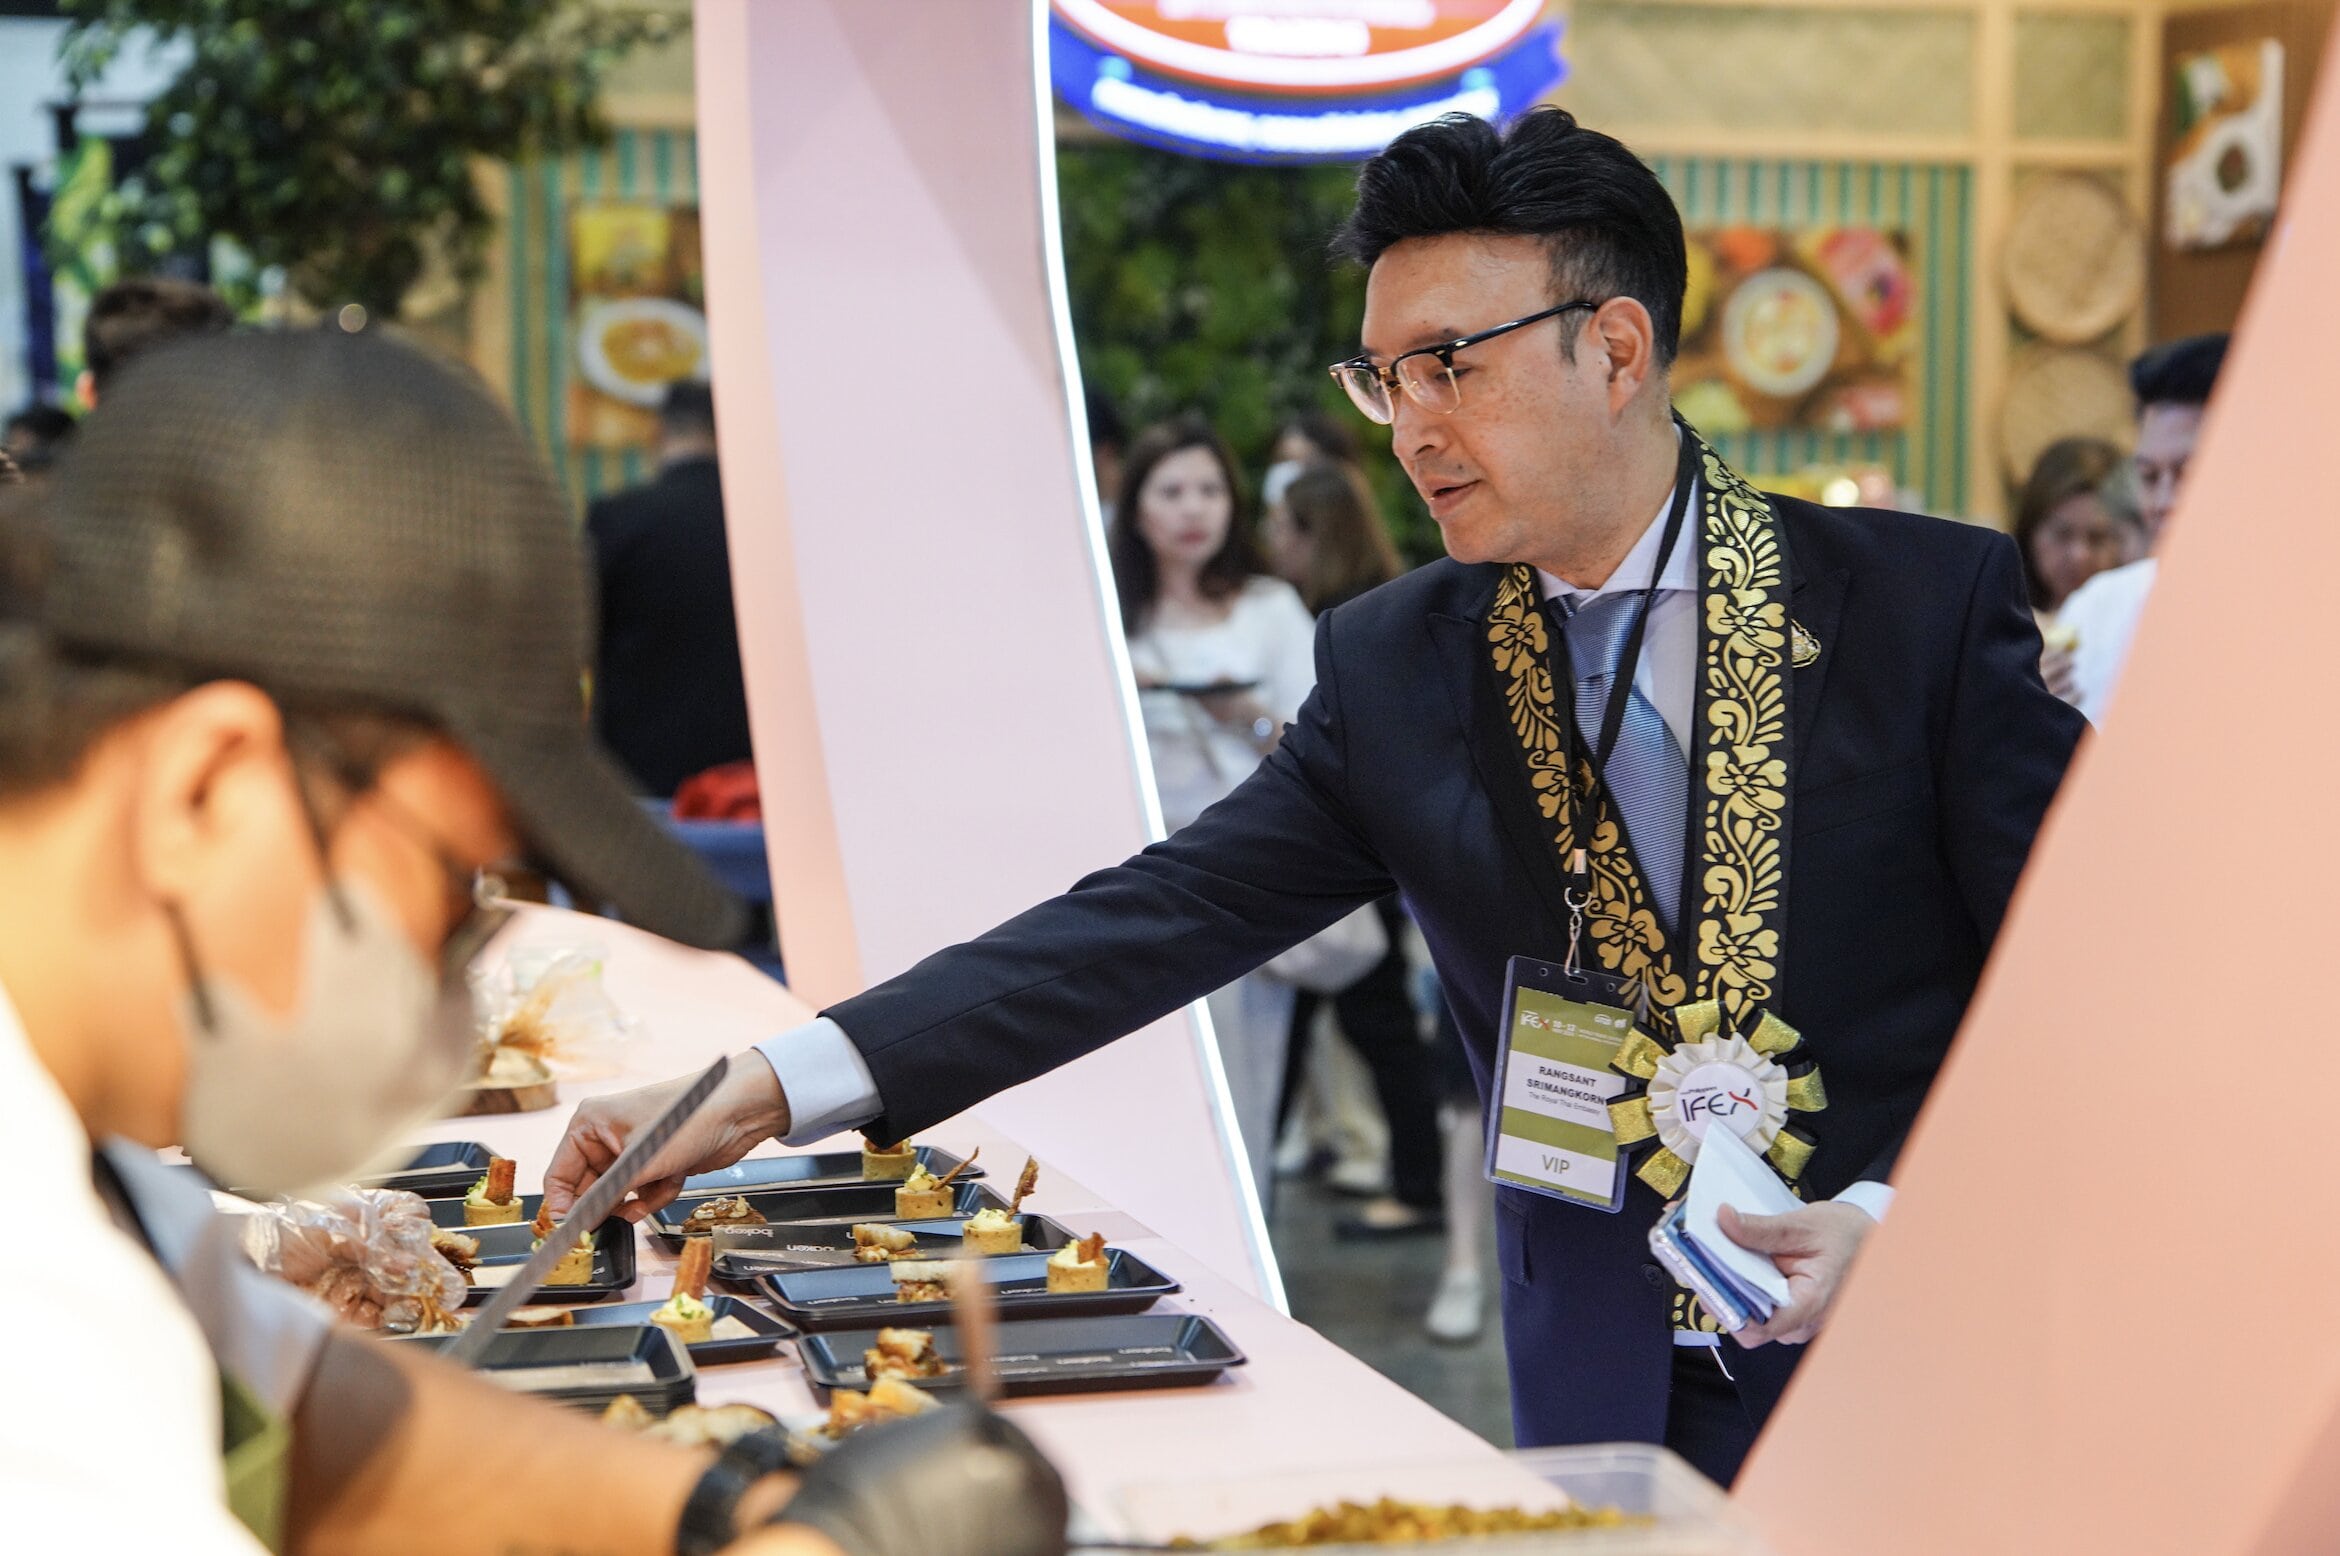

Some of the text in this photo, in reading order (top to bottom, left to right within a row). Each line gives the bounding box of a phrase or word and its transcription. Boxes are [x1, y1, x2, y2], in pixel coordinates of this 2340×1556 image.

[1538, 1066, 1597, 1088] RANGSANT
[1526, 1078, 1605, 1105] SRIMANGKORN
[1528, 1091, 1540, 1100] The
[1682, 1088, 1758, 1122] IFEX
[1542, 1154, 1570, 1175] VIP
